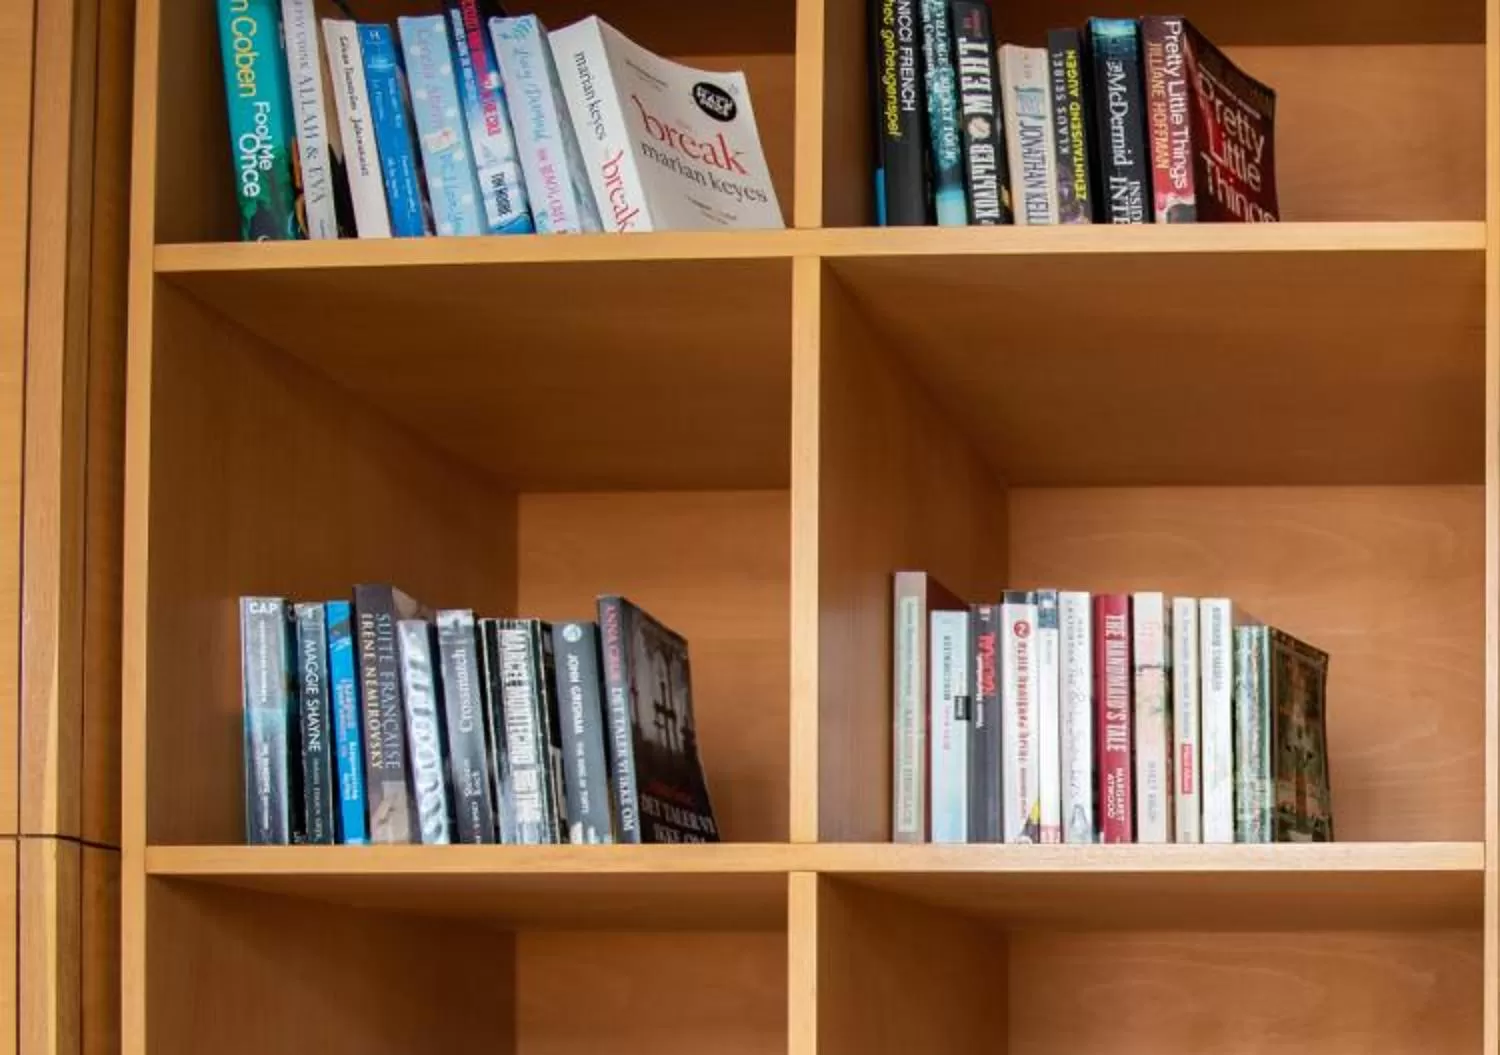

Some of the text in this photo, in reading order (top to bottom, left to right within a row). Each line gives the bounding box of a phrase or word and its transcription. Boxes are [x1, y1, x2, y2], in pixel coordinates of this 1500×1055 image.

[232, 16, 260, 98] Coben
[573, 50, 608, 142] marian keyes
[880, 0, 903, 138] het geheugenspel
[897, 0, 917, 112] NICCI FRENCH
[254, 102, 275, 171] Fool Me
[299, 75, 326, 205] ALLAH & EVA
[630, 94, 750, 177] break
[1052, 51, 1071, 155] KLAUS SEIBEL
[1064, 48, 1088, 201] ZEHNTAUSEND AUGEN
[1107, 72, 1134, 166] McDermid
[1148, 41, 1171, 169] JILLIANE HOFFMAN
[1162, 20, 1192, 189] Pretty Little Things
[1197, 70, 1266, 164] Pretty
[239, 133, 261, 198] Once
[600, 150, 642, 233] break
[640, 141, 770, 206] marian keyes
[1018, 119, 1047, 188] JONATHAN
[1206, 115, 1262, 193] Little
[1109, 174, 1131, 223] INTE
[303, 639, 323, 753] MAGGIE SHAYNE
[376, 612, 402, 770] SUITE FRANÇAISE
[453, 649, 474, 734] Crossmatch
[499, 628, 533, 683] MARCEL
[567, 653, 586, 736] JOHN GRISHAM
[1104, 614, 1128, 753] THE HANDMAID'S TALE
[621, 807, 636, 831] OM
[1106, 773, 1117, 819] ATWOOD
[1114, 767, 1126, 822] MARGARET
